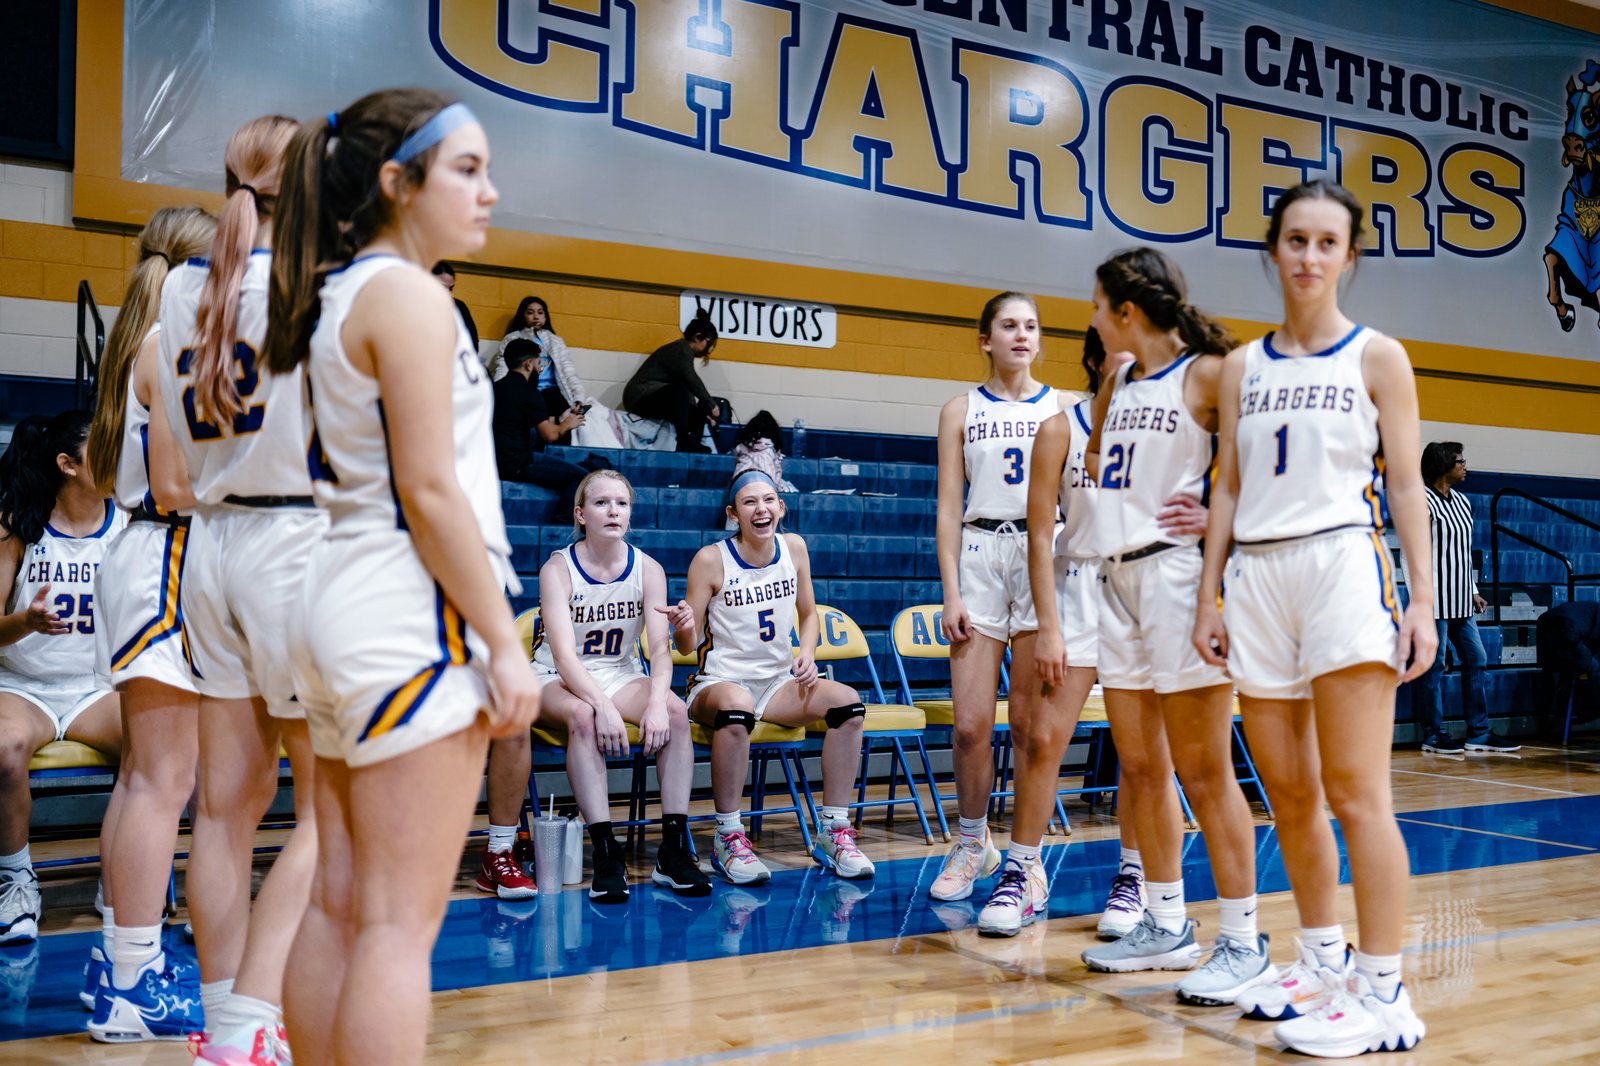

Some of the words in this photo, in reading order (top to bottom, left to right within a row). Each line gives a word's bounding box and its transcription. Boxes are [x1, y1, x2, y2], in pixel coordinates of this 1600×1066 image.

[1245, 25, 1528, 141] CATHOLIC
[428, 0, 1526, 258] CHARGERS
[1003, 447, 1024, 485] 3
[1101, 442, 1136, 489] 21
[1273, 422, 1289, 477] 1
[582, 627, 625, 656] 20
[757, 608, 776, 642] 5
